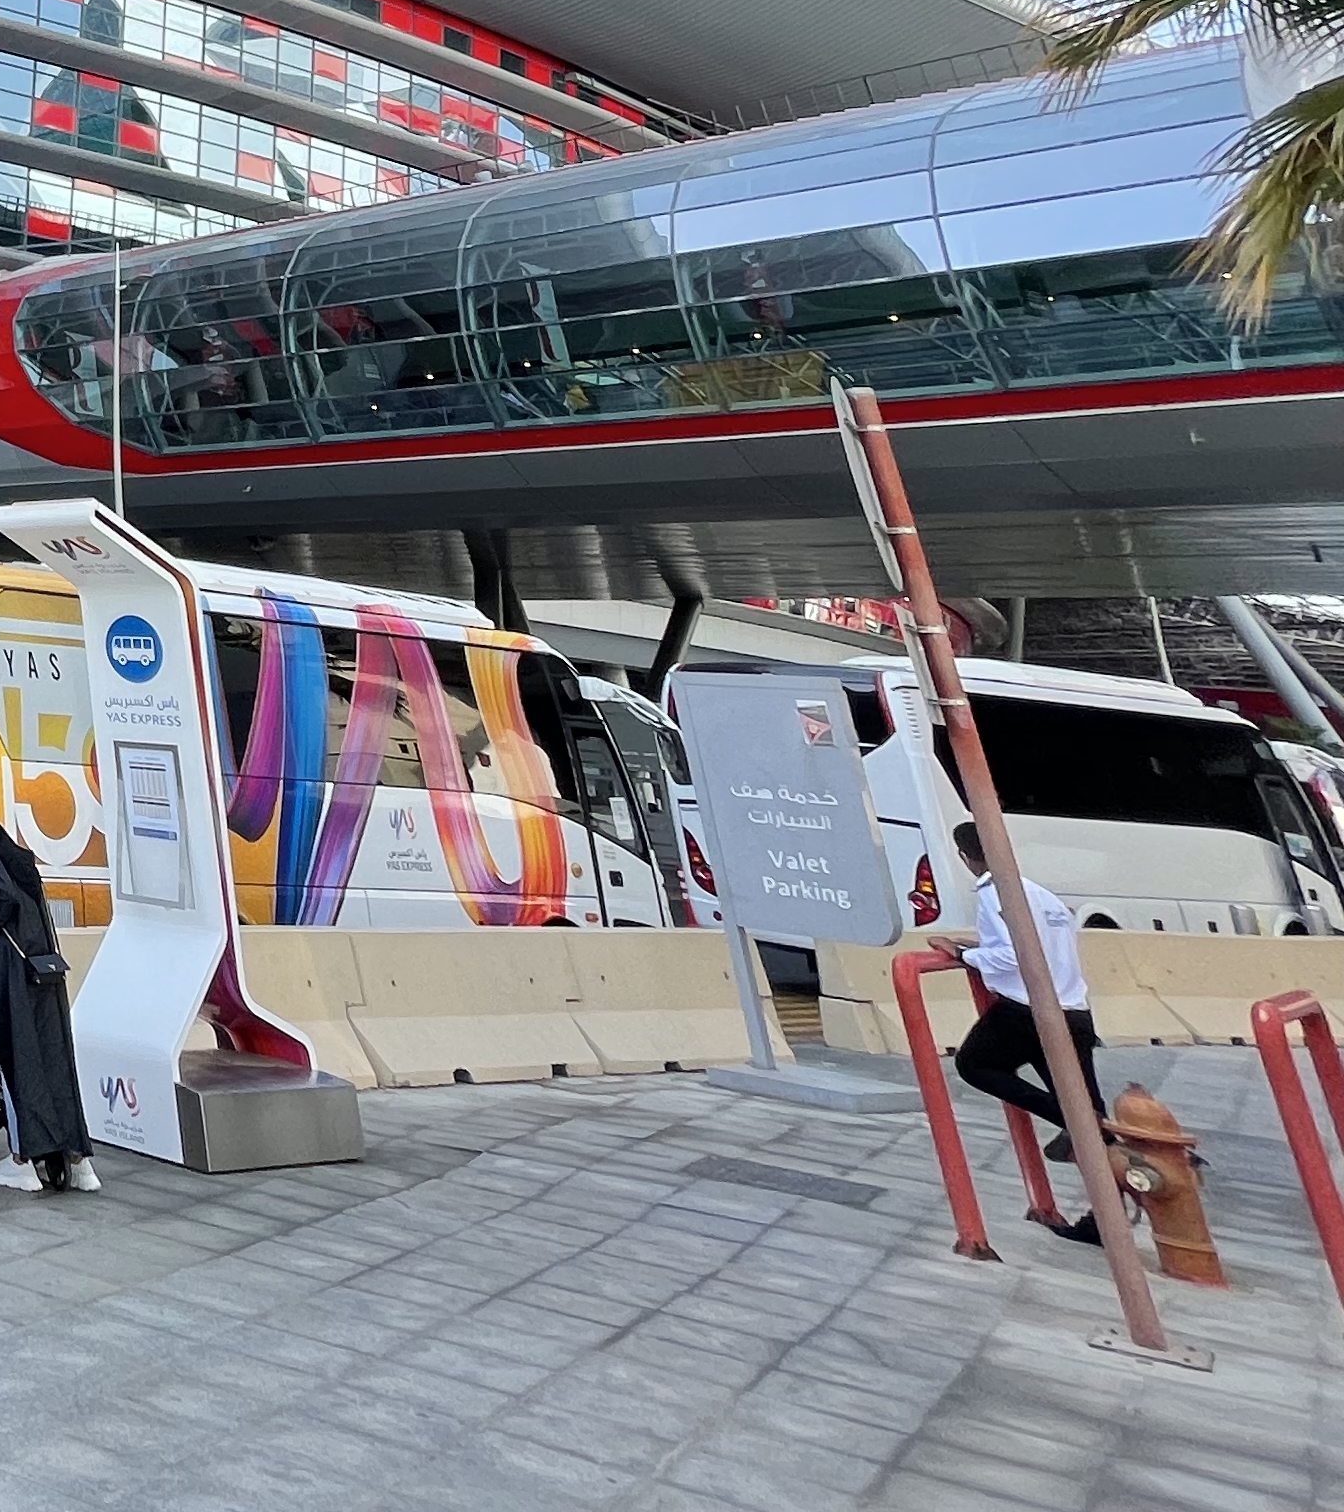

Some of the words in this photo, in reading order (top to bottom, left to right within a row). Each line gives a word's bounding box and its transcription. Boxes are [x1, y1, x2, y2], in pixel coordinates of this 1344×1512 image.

[3, 648, 62, 681] YAS
[157, 696, 180, 711] ياس
[106, 712, 128, 723] YAS
[131, 713, 182, 727] EXPRESS
[730, 781, 773, 799] صف
[777, 784, 839, 805] خدمة
[748, 809, 832, 831] السيارات
[767, 849, 831, 874] Valet
[762, 876, 852, 909] Parking
